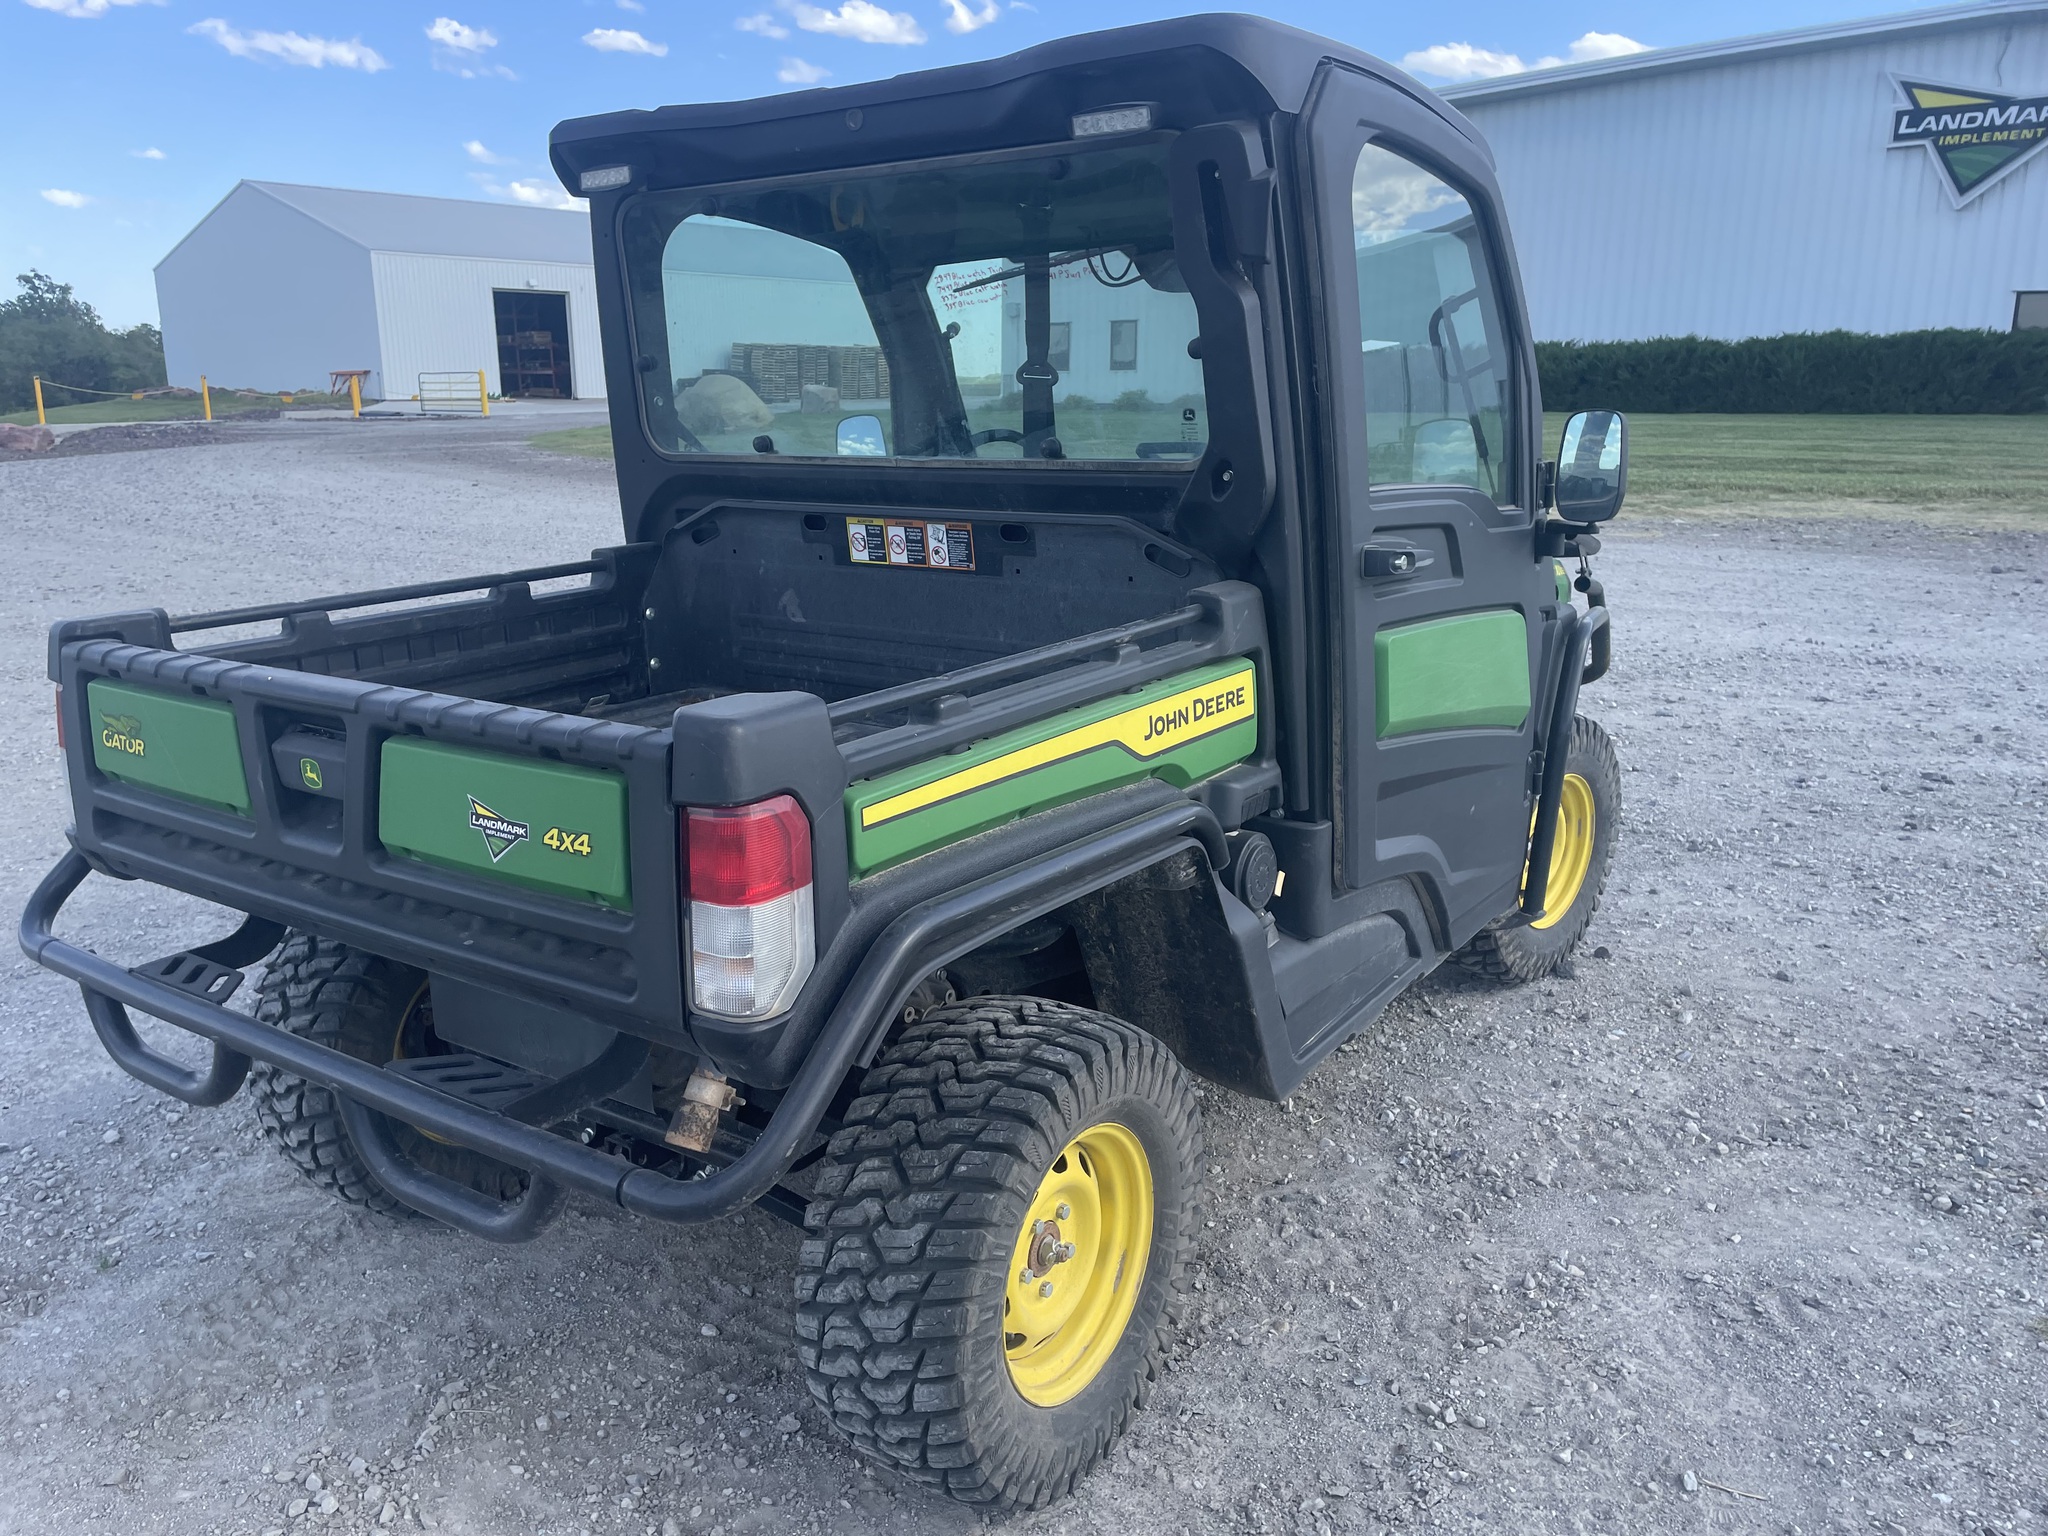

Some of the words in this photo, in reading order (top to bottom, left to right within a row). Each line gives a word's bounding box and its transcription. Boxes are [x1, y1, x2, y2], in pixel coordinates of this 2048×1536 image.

[1938, 127, 2047, 146] IMPLEMENT
[1144, 706, 1189, 741] JOHN
[1192, 686, 1245, 722] DEERE
[102, 729, 145, 757] GATOR
[472, 815, 527, 836] LANDMARK
[485, 829, 515, 840] IMPLEMENT
